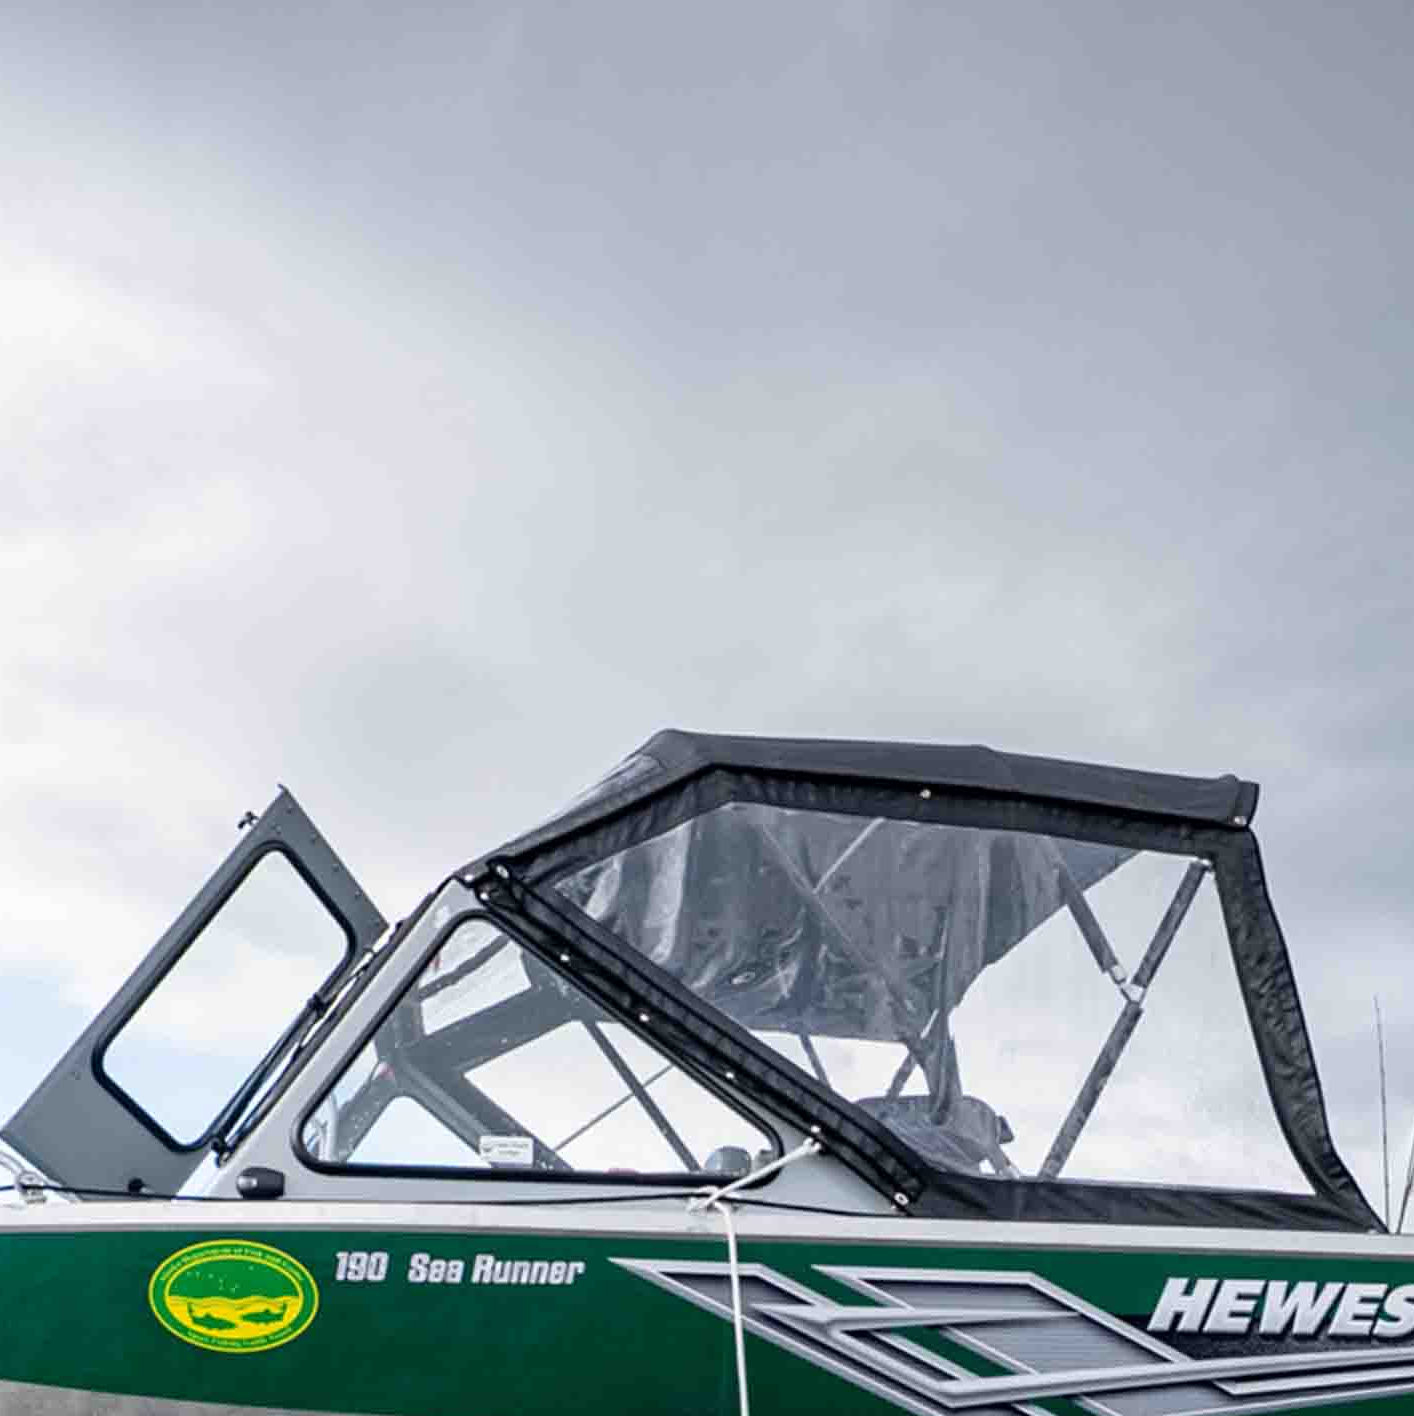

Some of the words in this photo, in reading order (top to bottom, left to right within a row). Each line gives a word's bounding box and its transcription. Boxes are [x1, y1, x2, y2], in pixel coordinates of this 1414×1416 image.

[335, 1252, 389, 1281] 190
[408, 1253, 465, 1283] Sea
[471, 1254, 586, 1284] Runner
